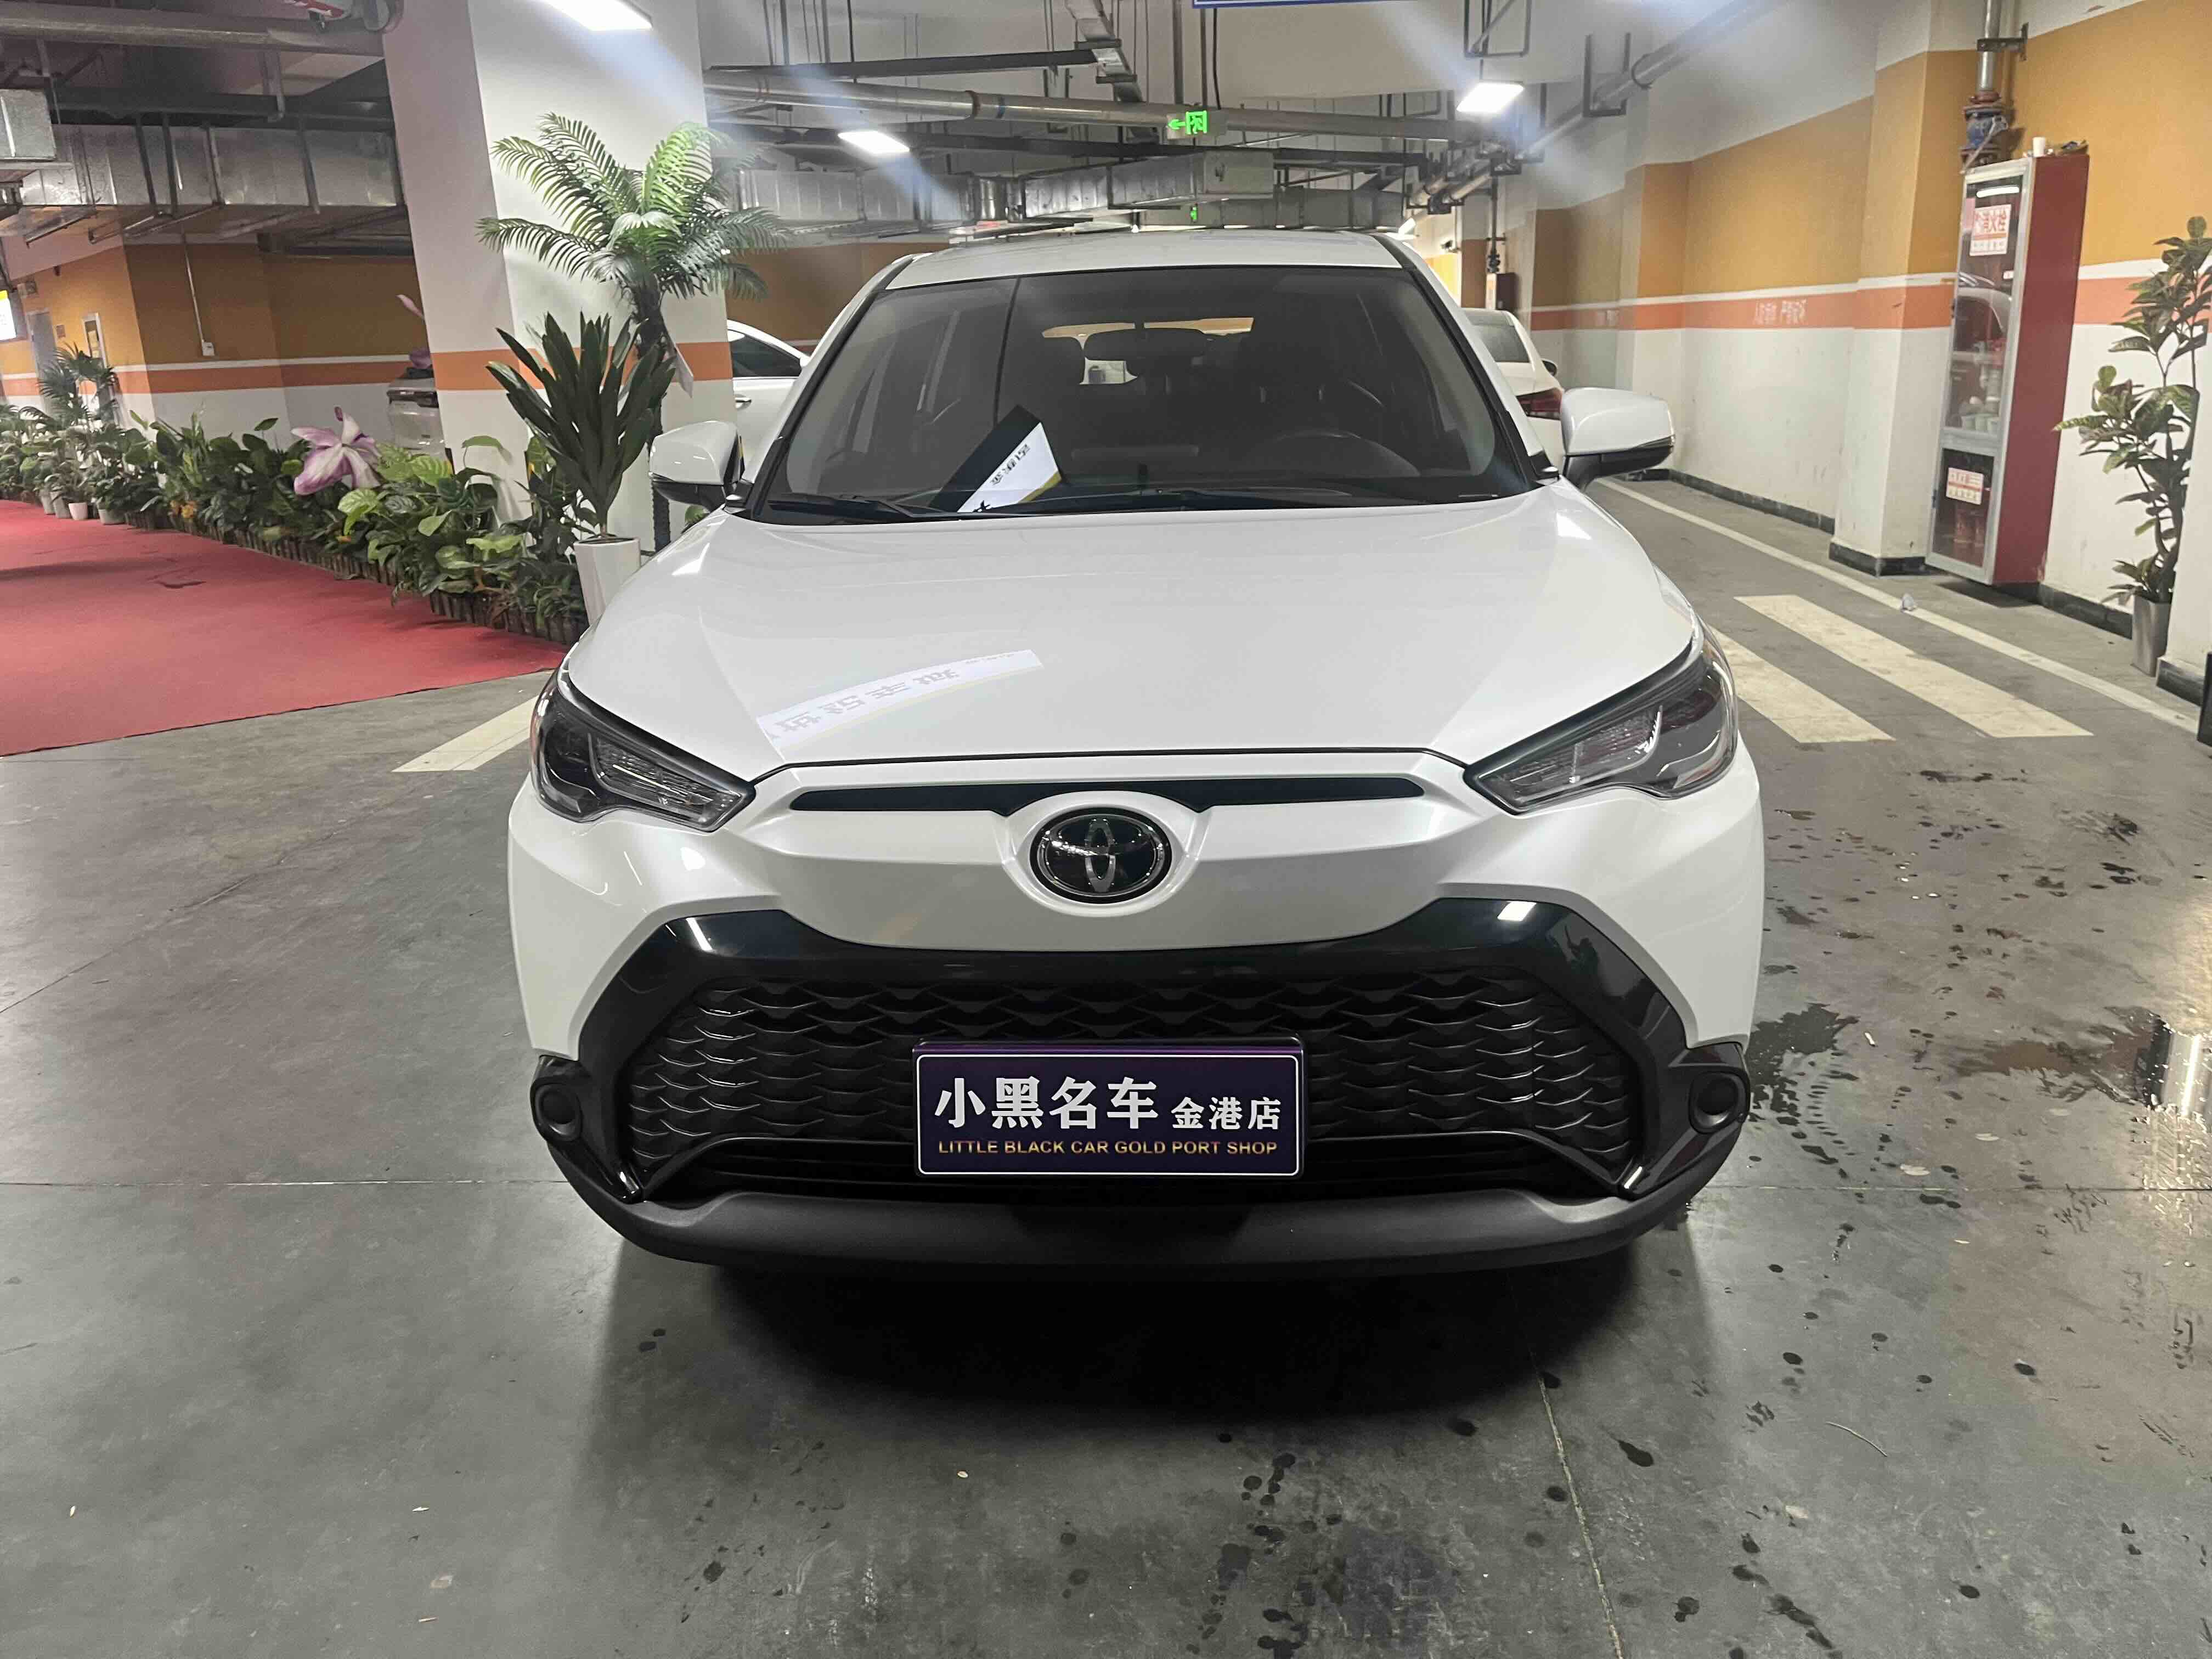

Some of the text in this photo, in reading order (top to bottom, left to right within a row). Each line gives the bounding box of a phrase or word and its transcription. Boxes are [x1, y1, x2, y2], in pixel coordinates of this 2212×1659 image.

[934, 1076, 1281, 1130] 小黑名车 金港店
[939, 1141, 1278, 1154] LITTLE BLACK CAR GOLD PORT SHOP
